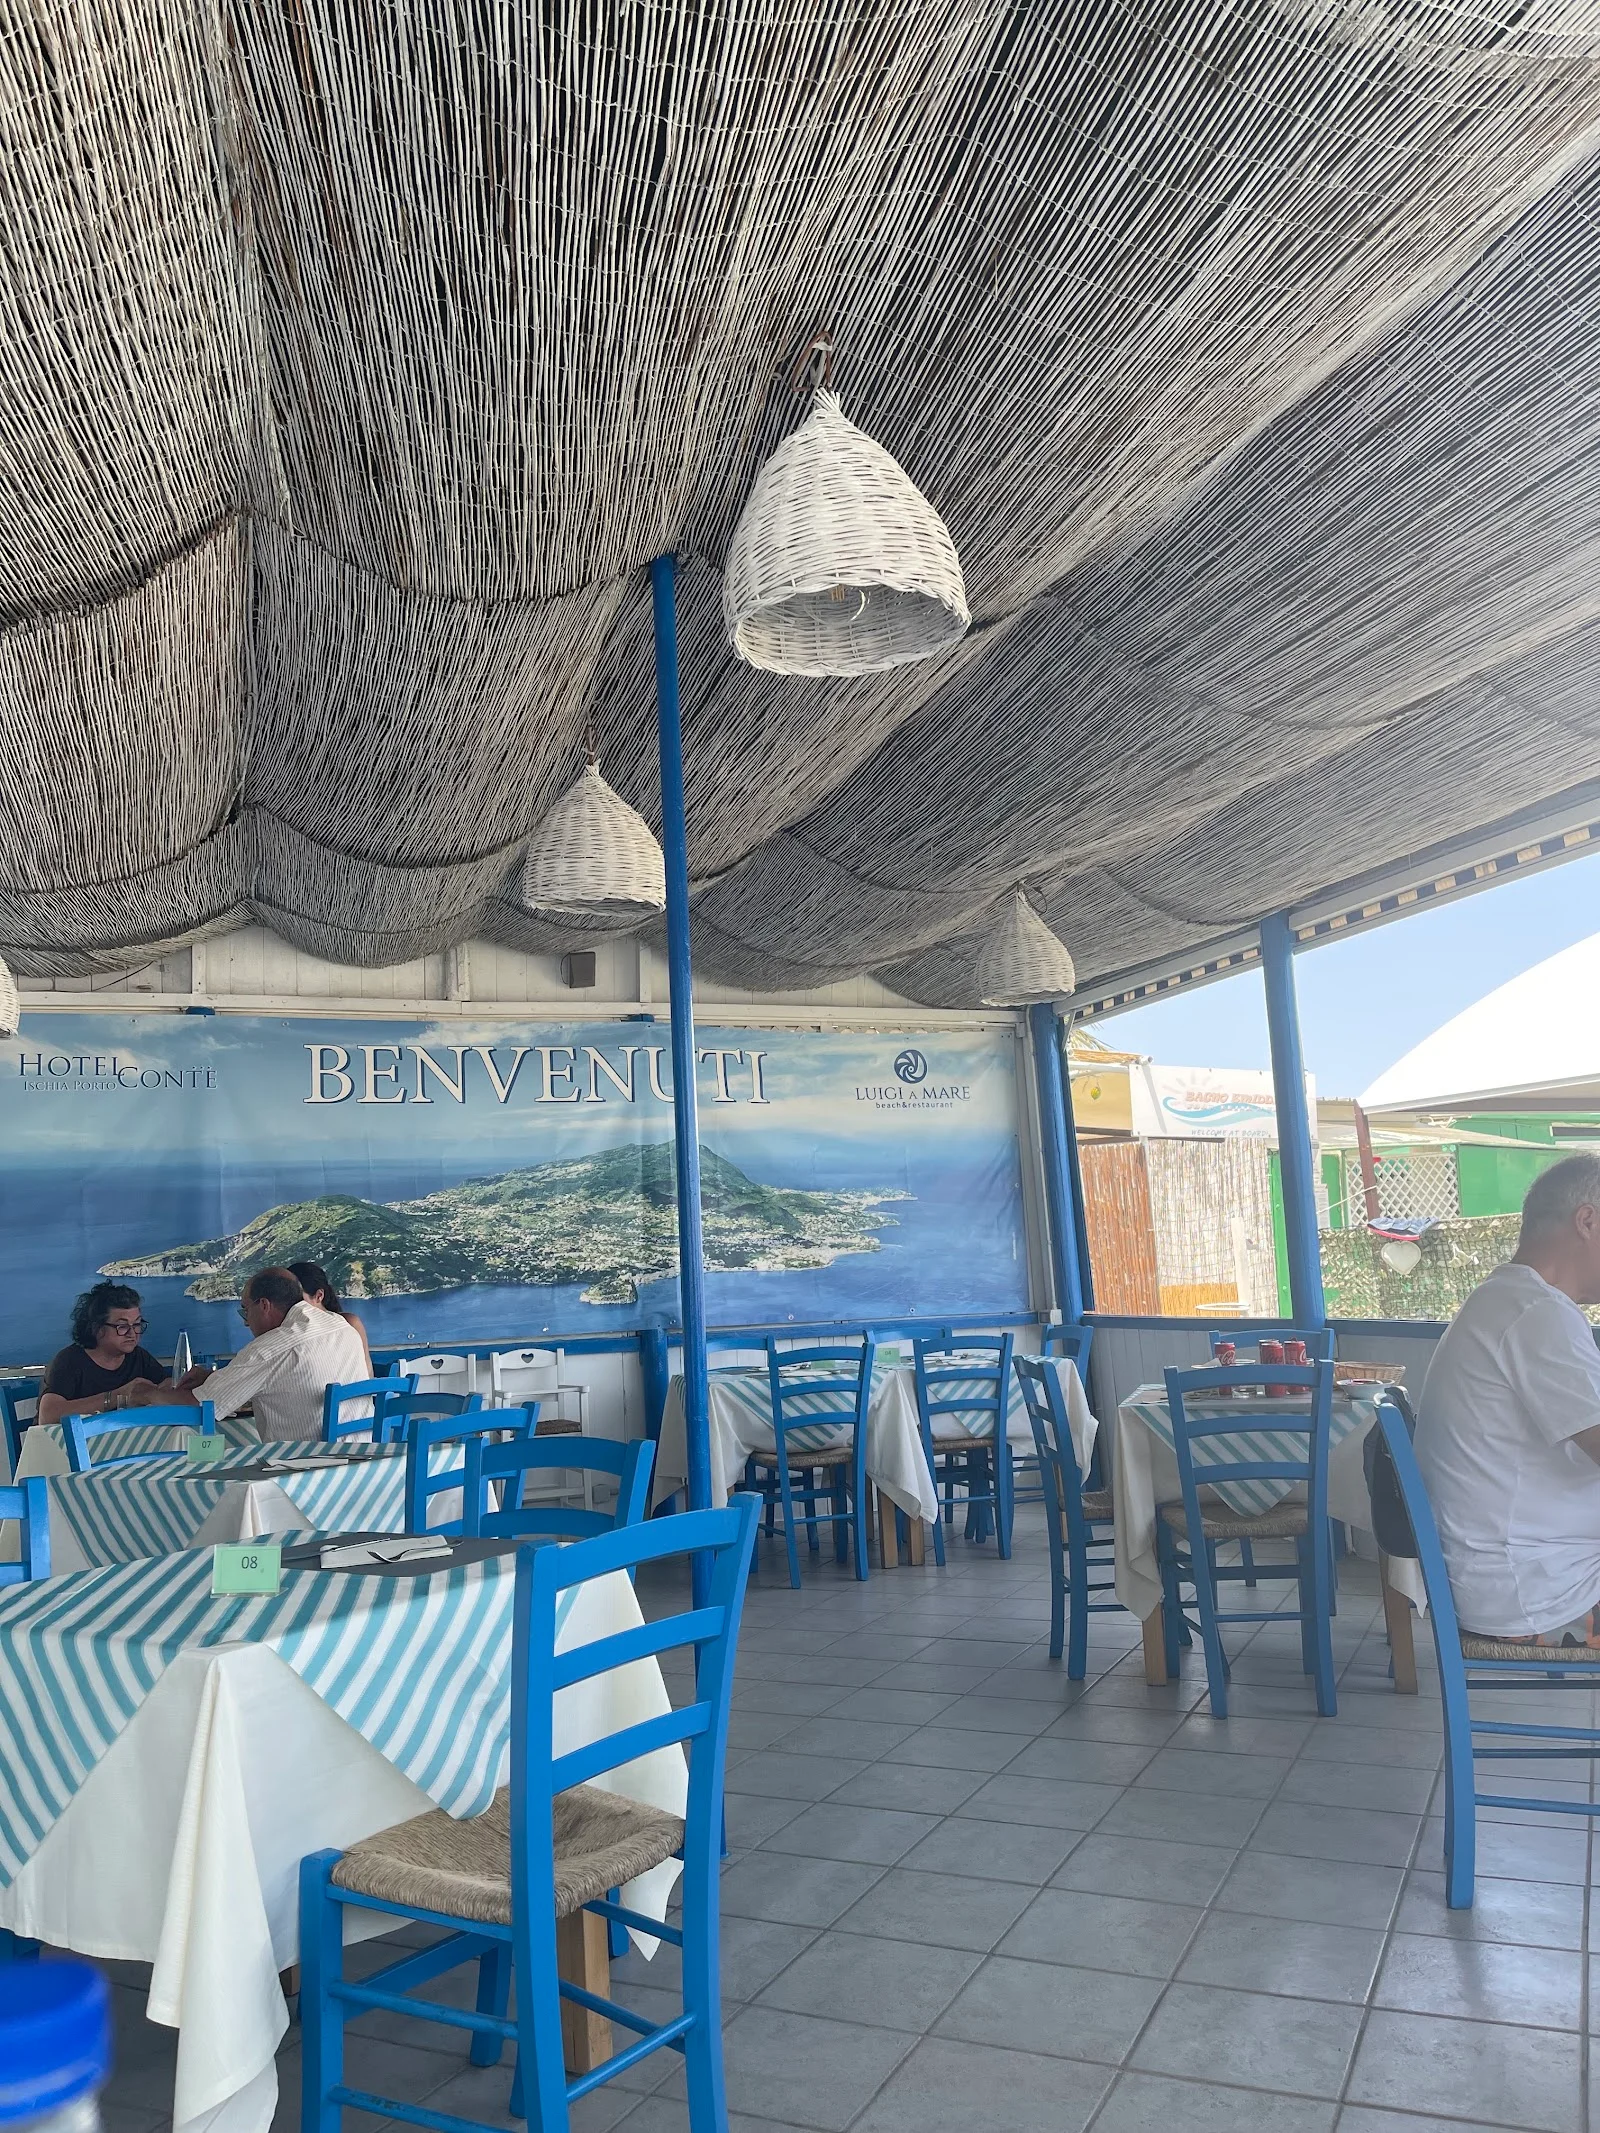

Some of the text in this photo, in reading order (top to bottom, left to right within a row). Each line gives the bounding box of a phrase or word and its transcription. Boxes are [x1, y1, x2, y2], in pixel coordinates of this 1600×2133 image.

[18, 1053, 124, 1077] HOTEL
[302, 1044, 772, 1104] BENVENUTI
[24, 1081, 117, 1091] ISCHIA PORTO
[855, 1086, 971, 1101] LUIGI A MARE
[1231, 1093, 1275, 1105] EMIDD
[1191, 1129, 1228, 1137] WELCOME
[201, 1440, 211, 1448] 07
[241, 1556, 258, 1569] 08
